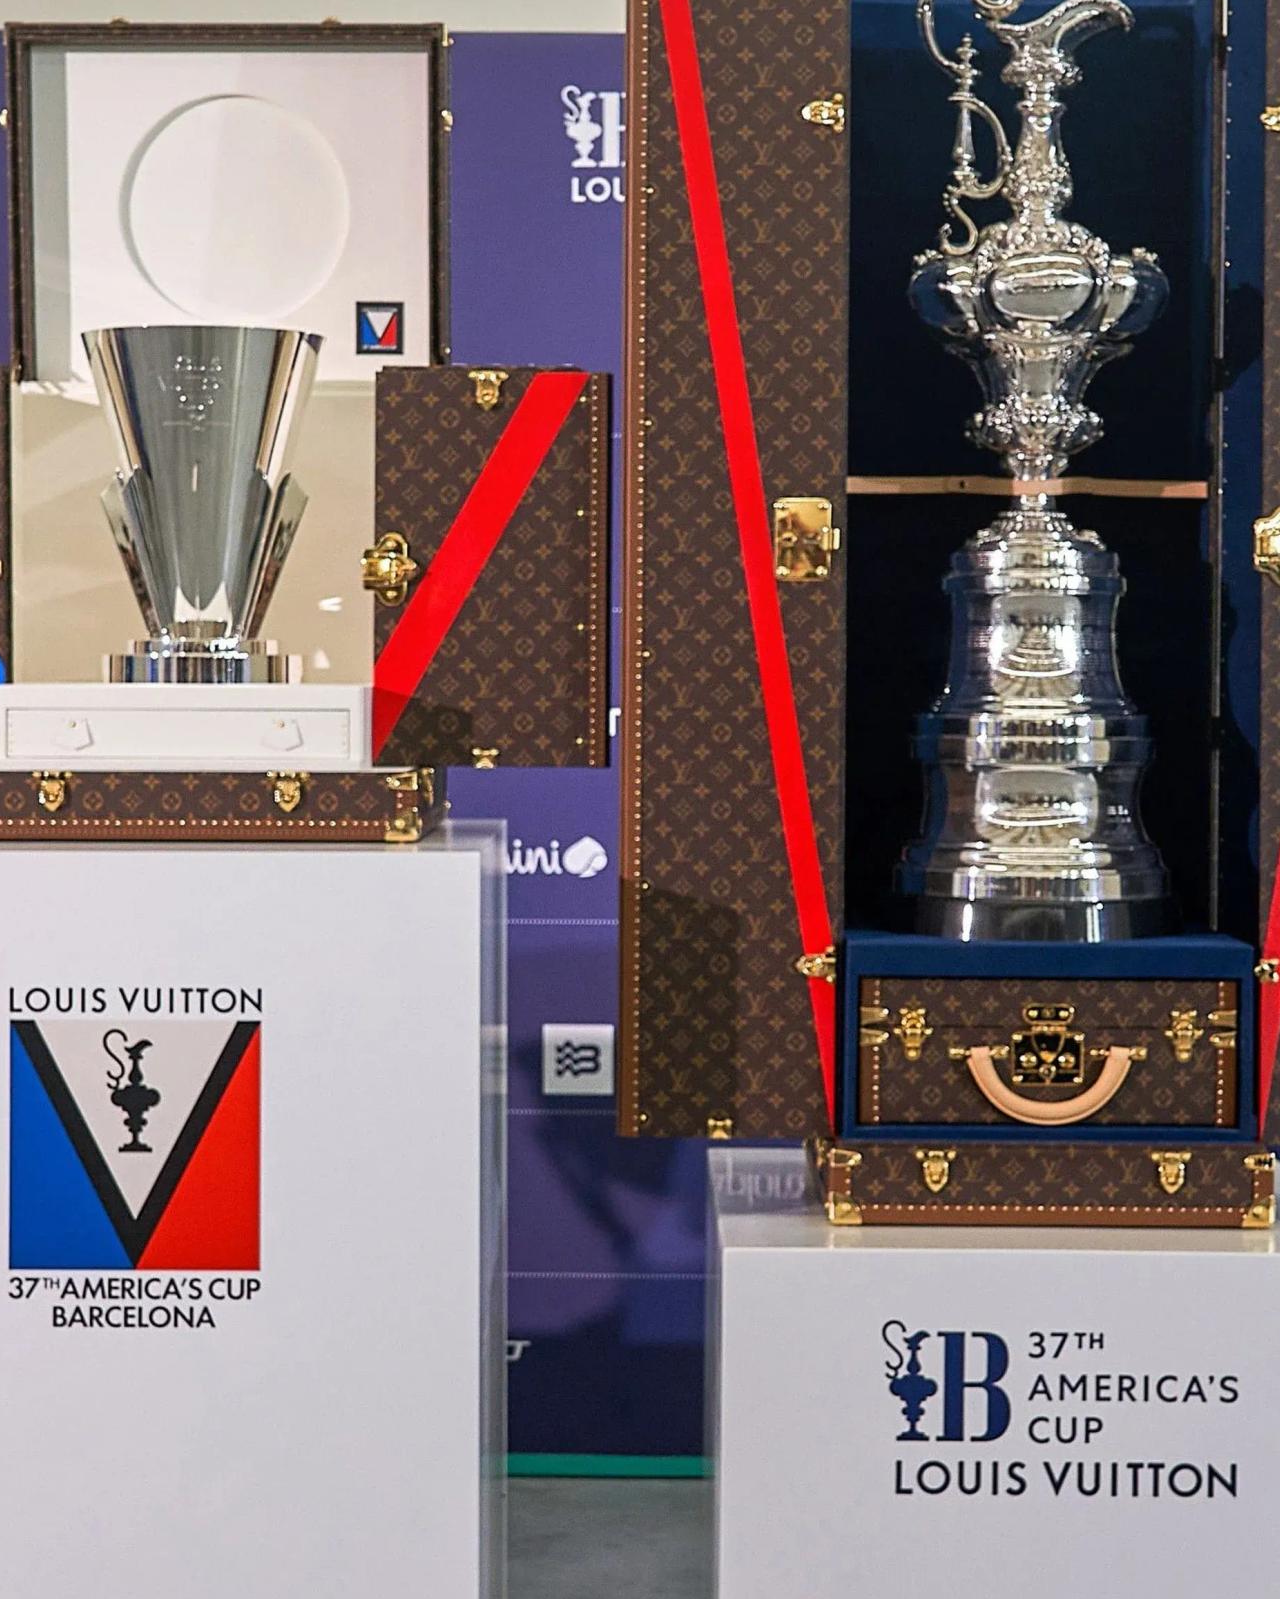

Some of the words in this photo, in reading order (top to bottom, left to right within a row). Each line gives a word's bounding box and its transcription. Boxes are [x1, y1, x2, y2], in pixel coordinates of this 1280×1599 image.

[9, 987, 107, 1013] LOUIS
[118, 987, 263, 1013] VUITTON
[61, 1278, 203, 1300] AMERICA'S
[208, 1278, 261, 1300] CUP
[52, 1306, 216, 1329] BARCELONA
[1028, 1332, 1104, 1359] 37TH
[1028, 1374, 1239, 1404] AMERICA'S
[1028, 1416, 1104, 1444] CUP
[895, 1460, 1027, 1497] LOUIS
[1042, 1462, 1237, 1499] VUITTON
